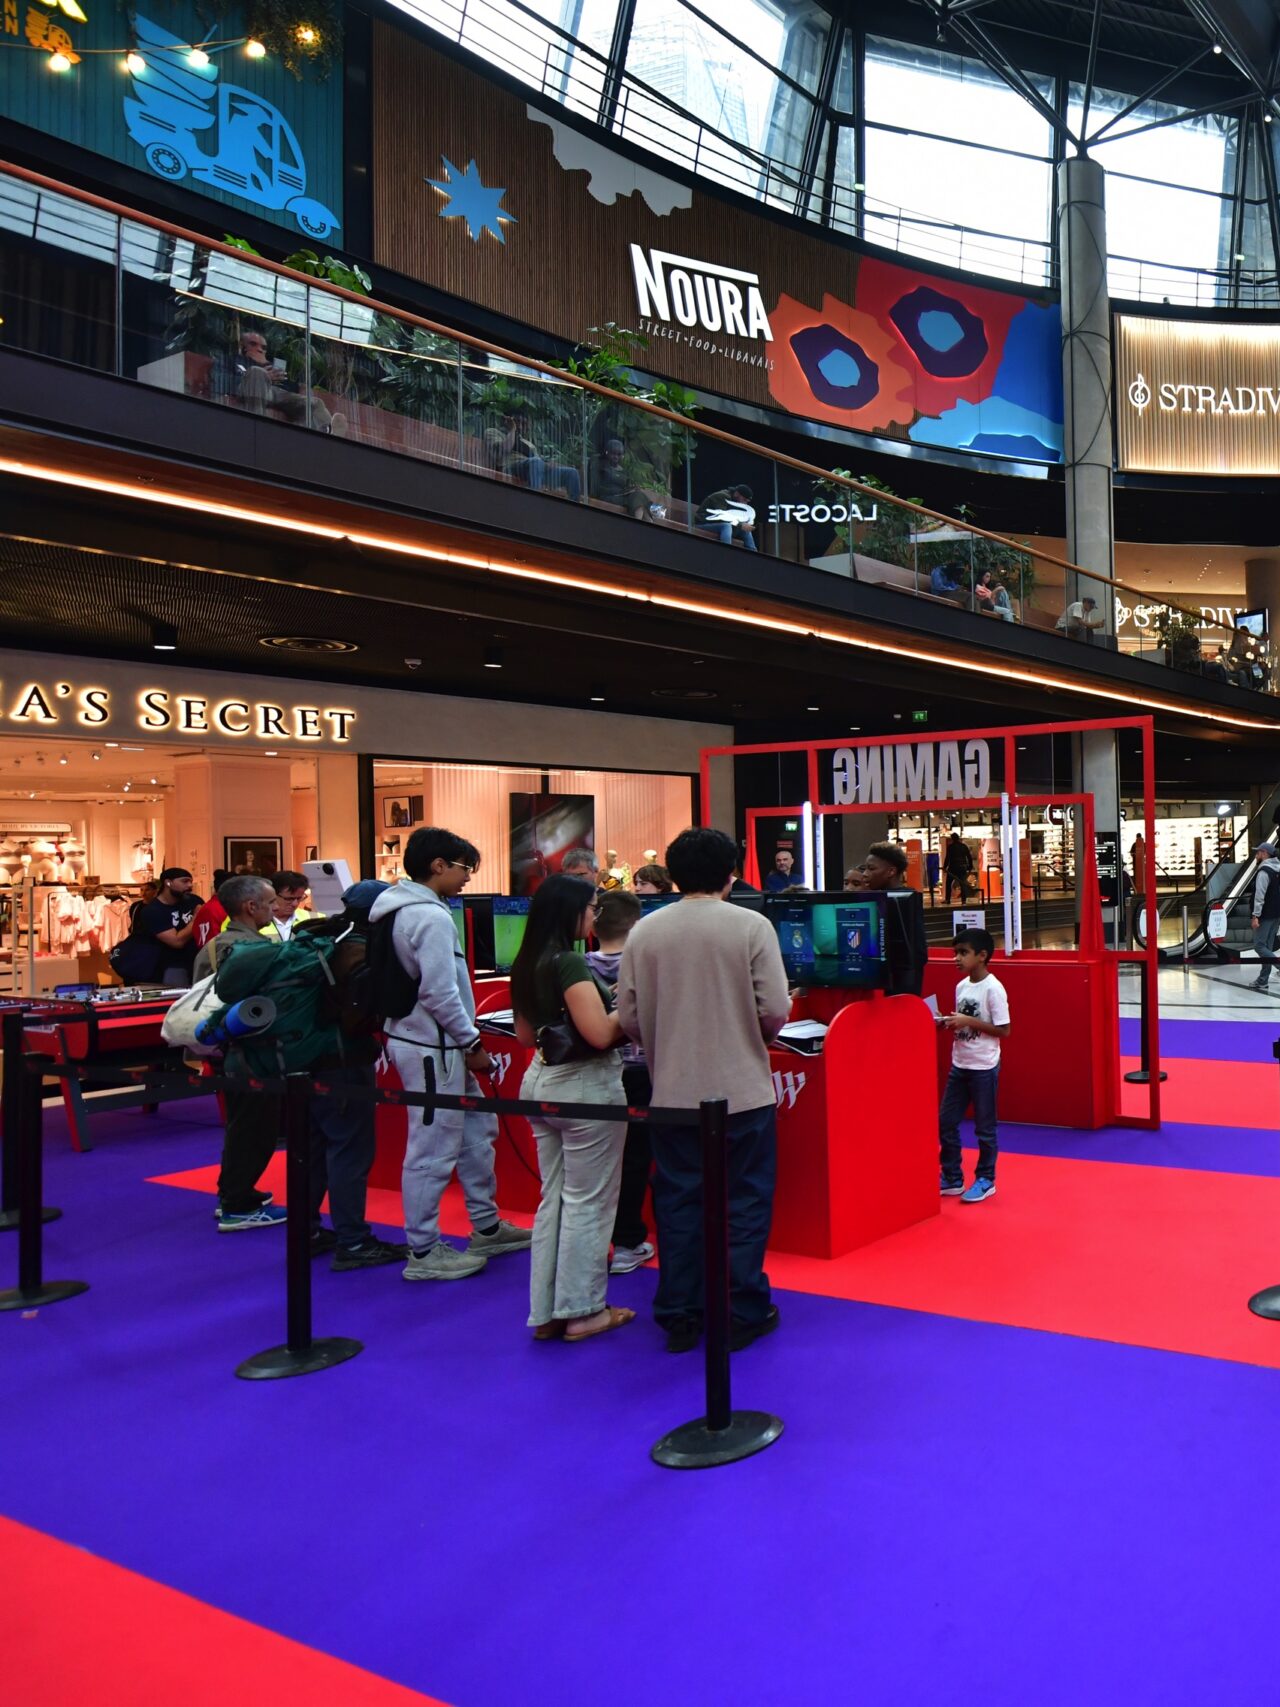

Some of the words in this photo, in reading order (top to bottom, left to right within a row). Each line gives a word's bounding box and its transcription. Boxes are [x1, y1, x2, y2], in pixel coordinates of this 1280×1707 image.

[630, 243, 774, 342] NOURA
[638, 318, 681, 343] STREET
[689, 335, 717, 355] FOOD
[724, 347, 774, 371] LIBANAIS
[12, 683, 110, 724] A'S
[143, 691, 356, 741] SECRET
